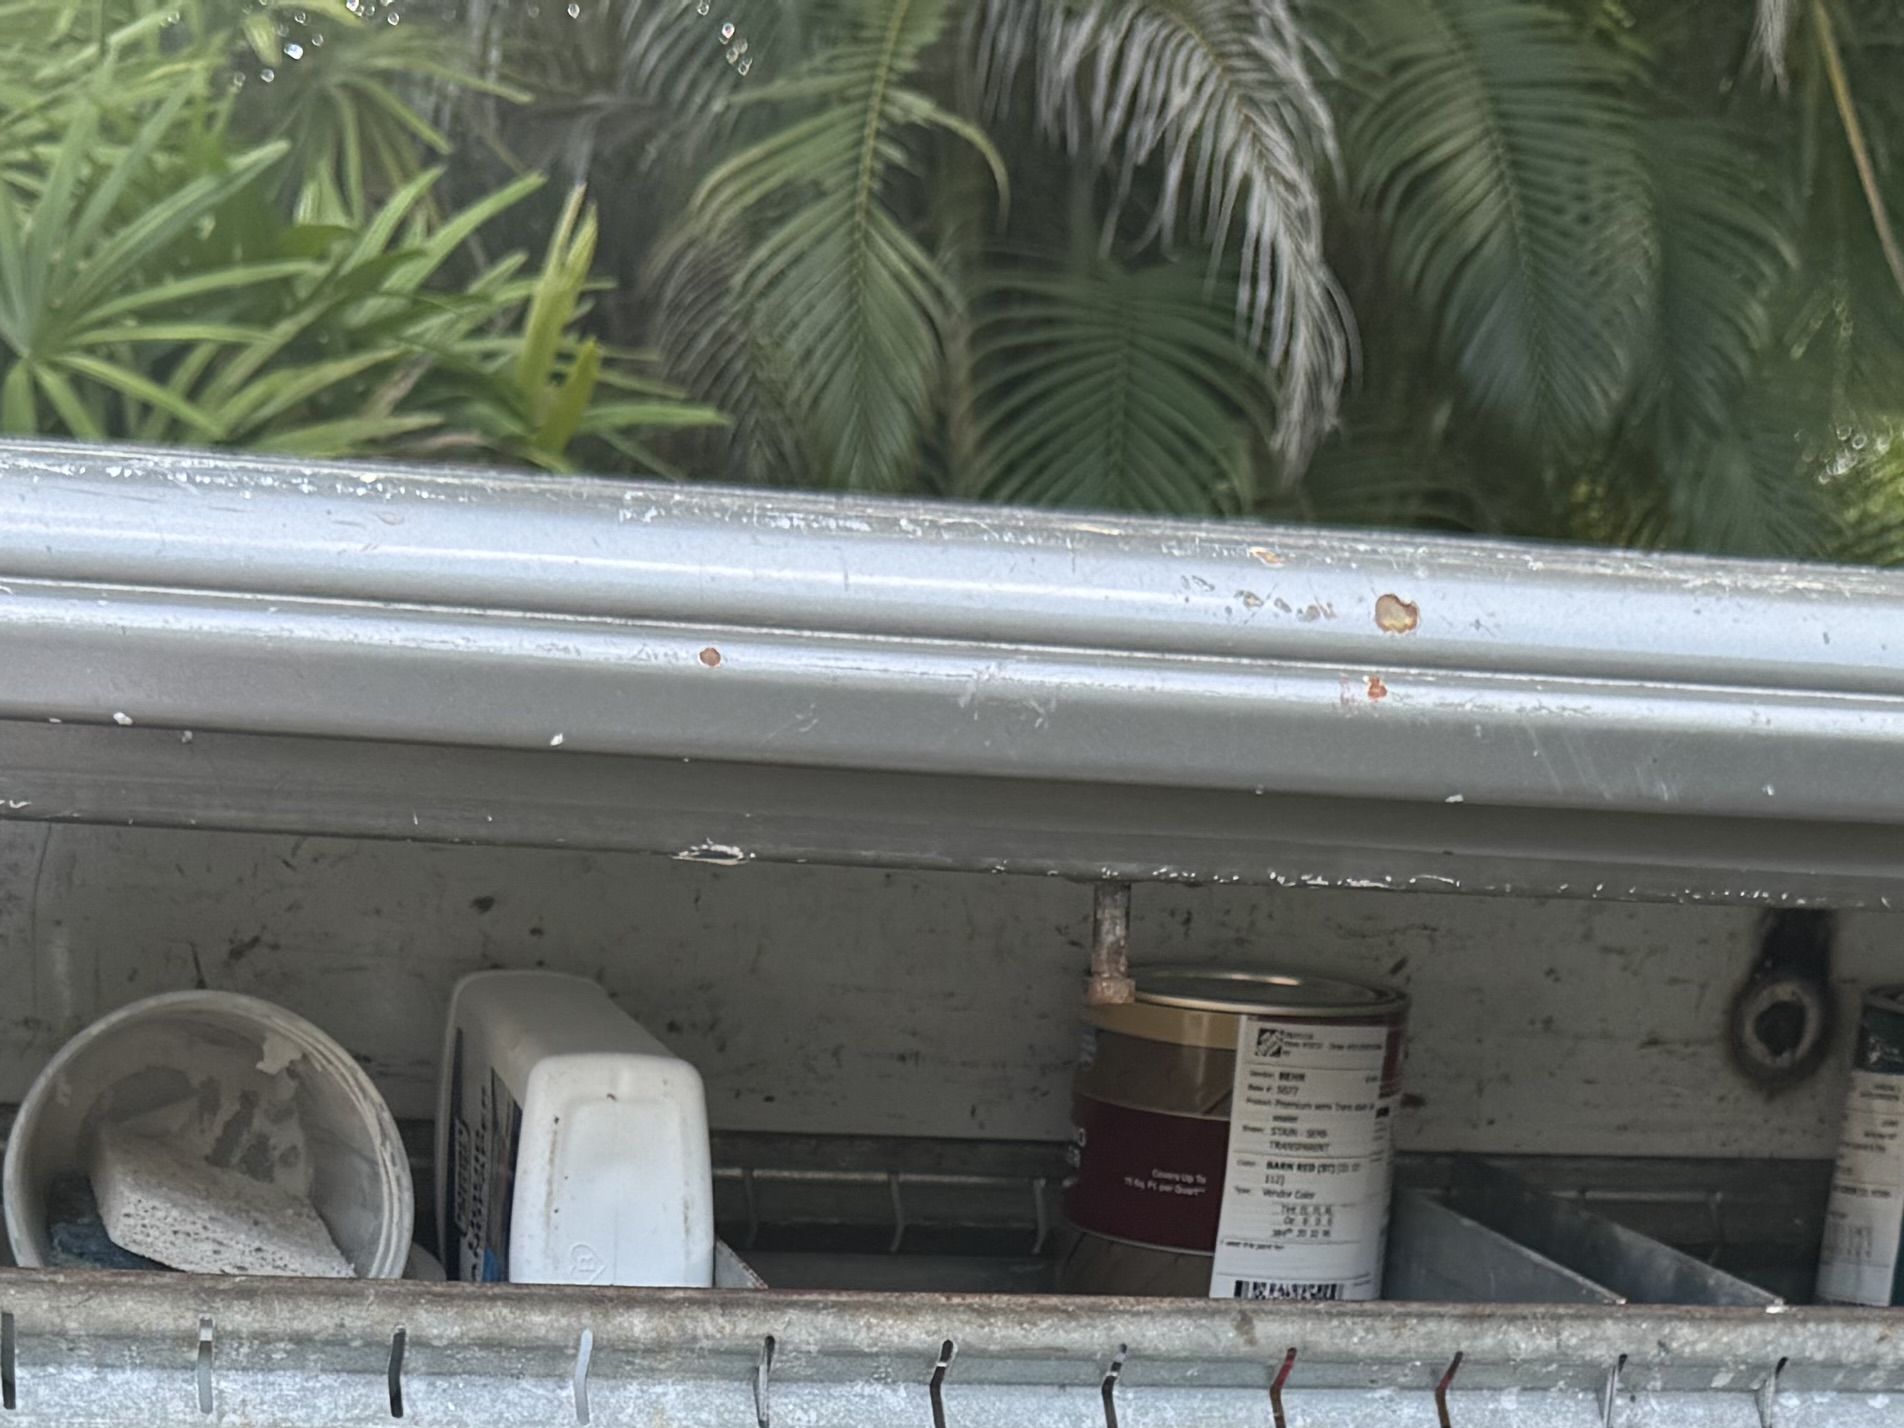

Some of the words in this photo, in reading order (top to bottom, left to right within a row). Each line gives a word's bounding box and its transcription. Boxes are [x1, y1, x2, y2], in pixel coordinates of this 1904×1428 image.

[1279, 1071, 1306, 1082] BEHR
[1266, 1161, 1295, 1173] BARN
[1296, 1162, 1317, 1173] RED
